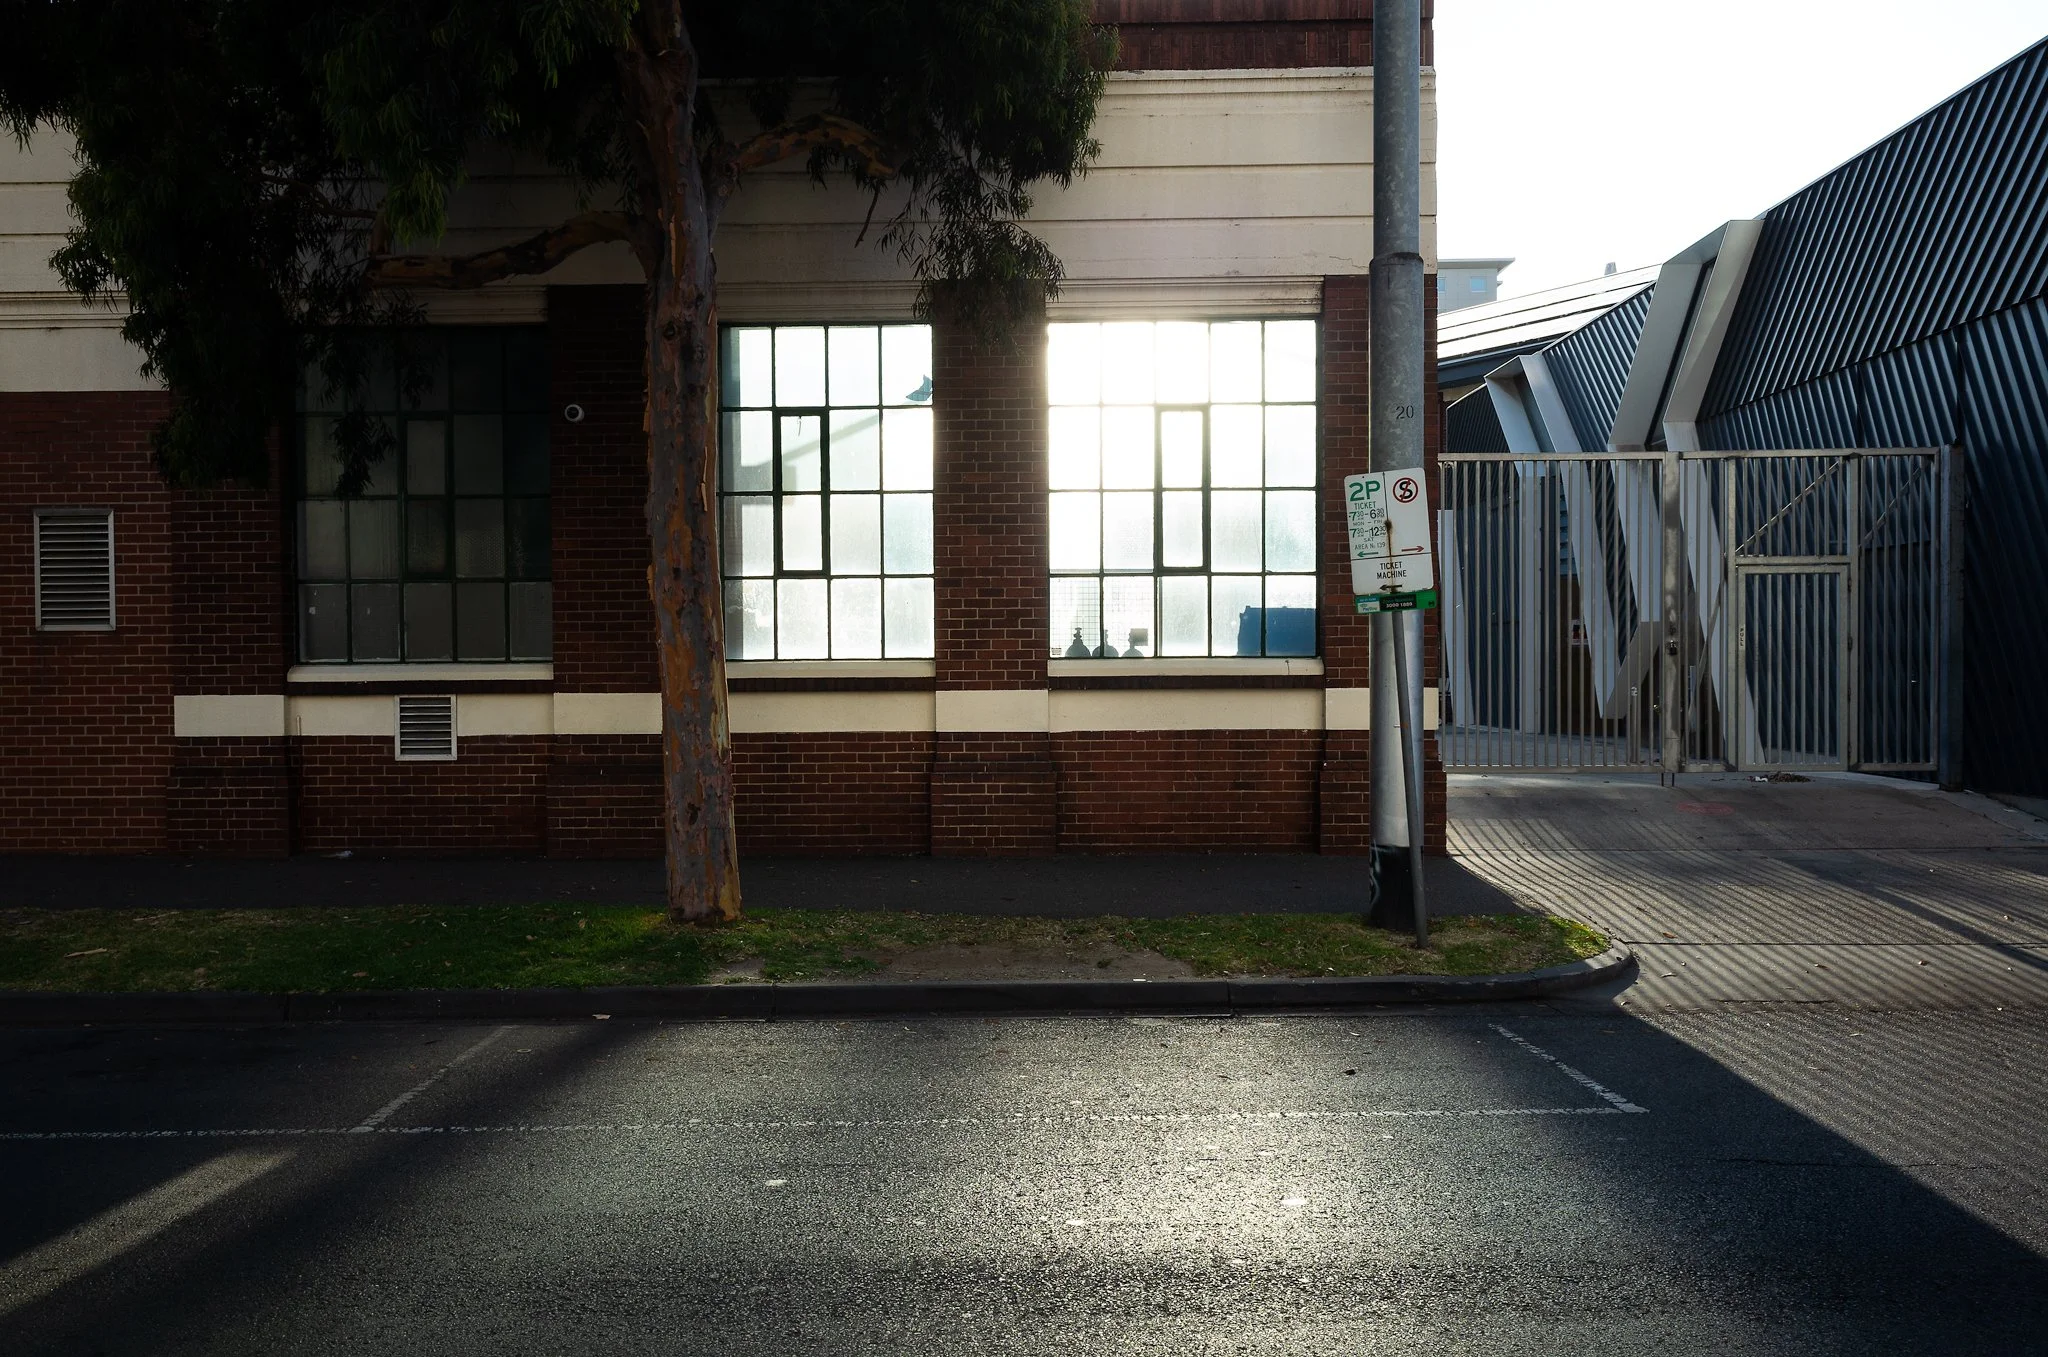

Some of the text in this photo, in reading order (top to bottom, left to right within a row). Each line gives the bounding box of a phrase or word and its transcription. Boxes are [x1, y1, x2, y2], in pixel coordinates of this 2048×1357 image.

[1396, 405, 1414, 419] 20
[1349, 480, 1381, 501] 2P
[1354, 501, 1376, 510] TICKET
[1380, 561, 1402, 570] TICKET
[1376, 569, 1407, 579] MACHINE
